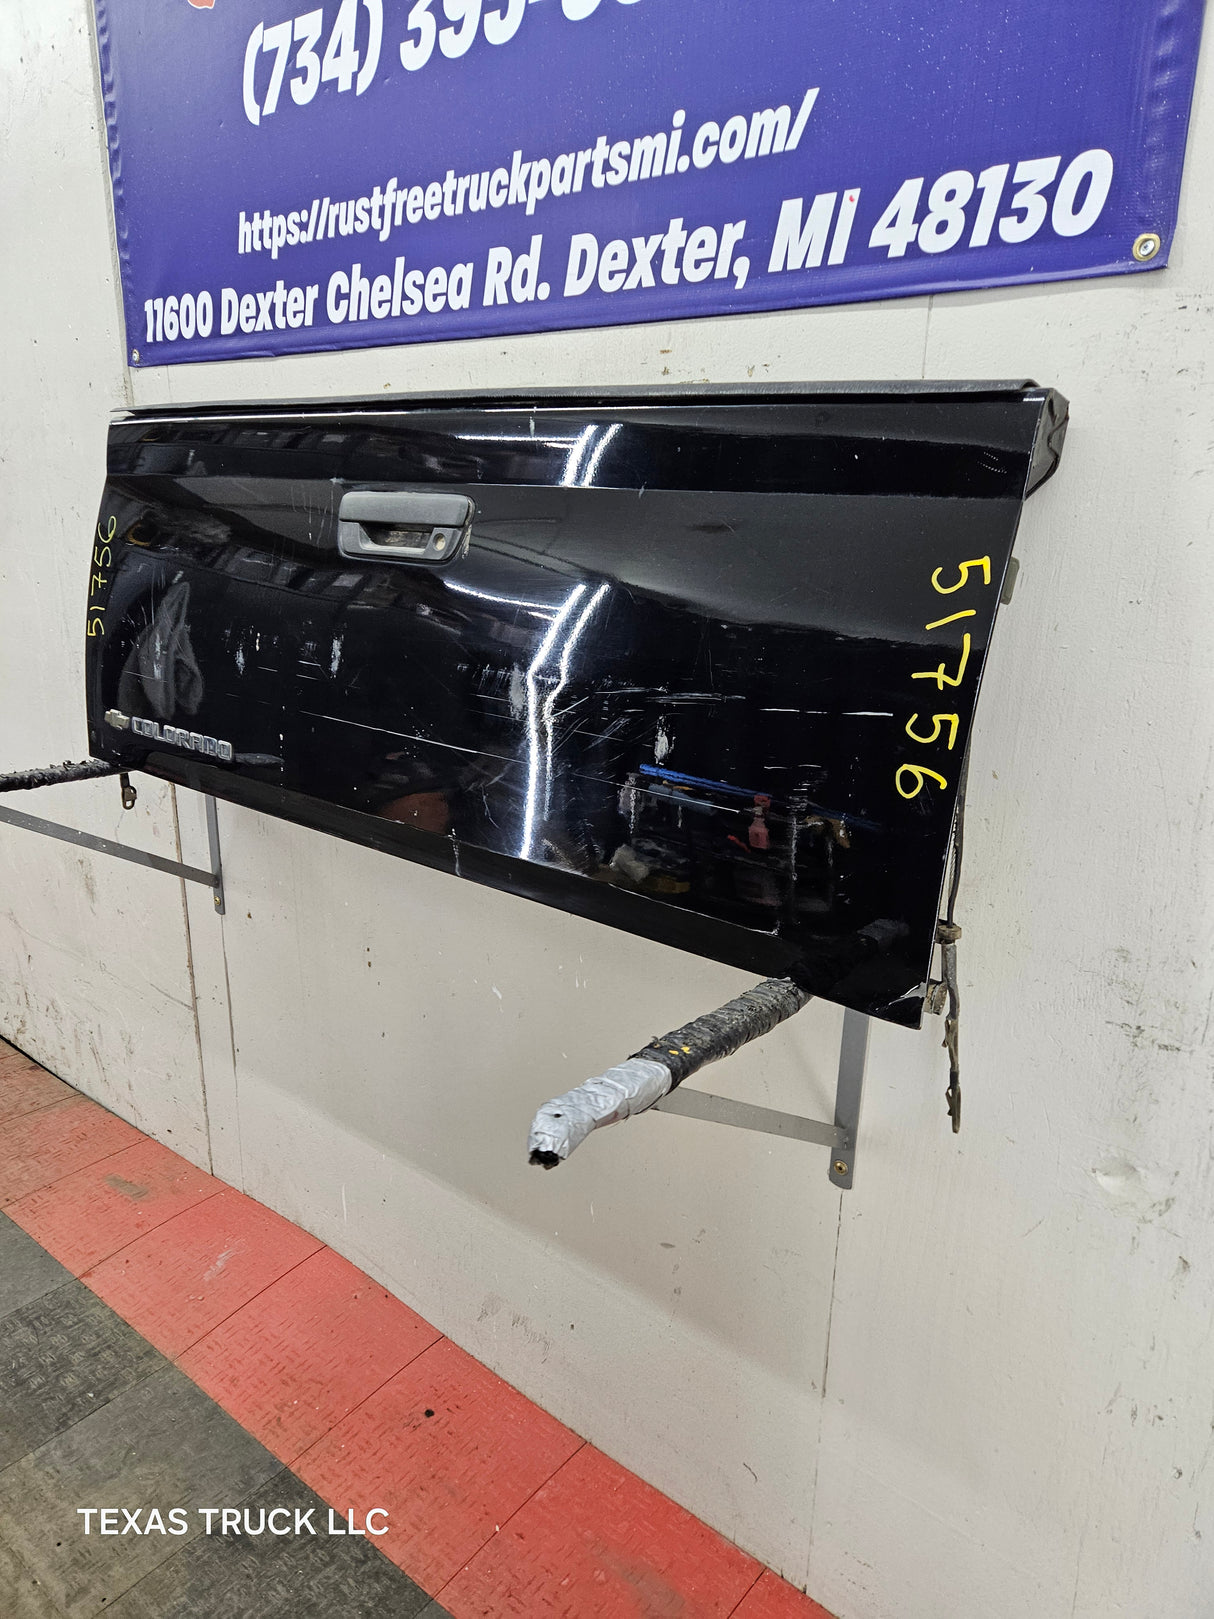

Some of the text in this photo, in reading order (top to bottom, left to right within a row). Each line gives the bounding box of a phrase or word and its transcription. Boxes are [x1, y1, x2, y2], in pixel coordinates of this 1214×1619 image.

[242, 0, 383, 126] (734)
[143, 148, 1115, 343] 11600 Dexter Chelsea Rd. Dexter, MI 48130
[237, 87, 820, 259] https://rustfreetruckpartsmi.com/
[131, 716, 233, 761] COLORADO
[895, 555, 991, 799] 51756
